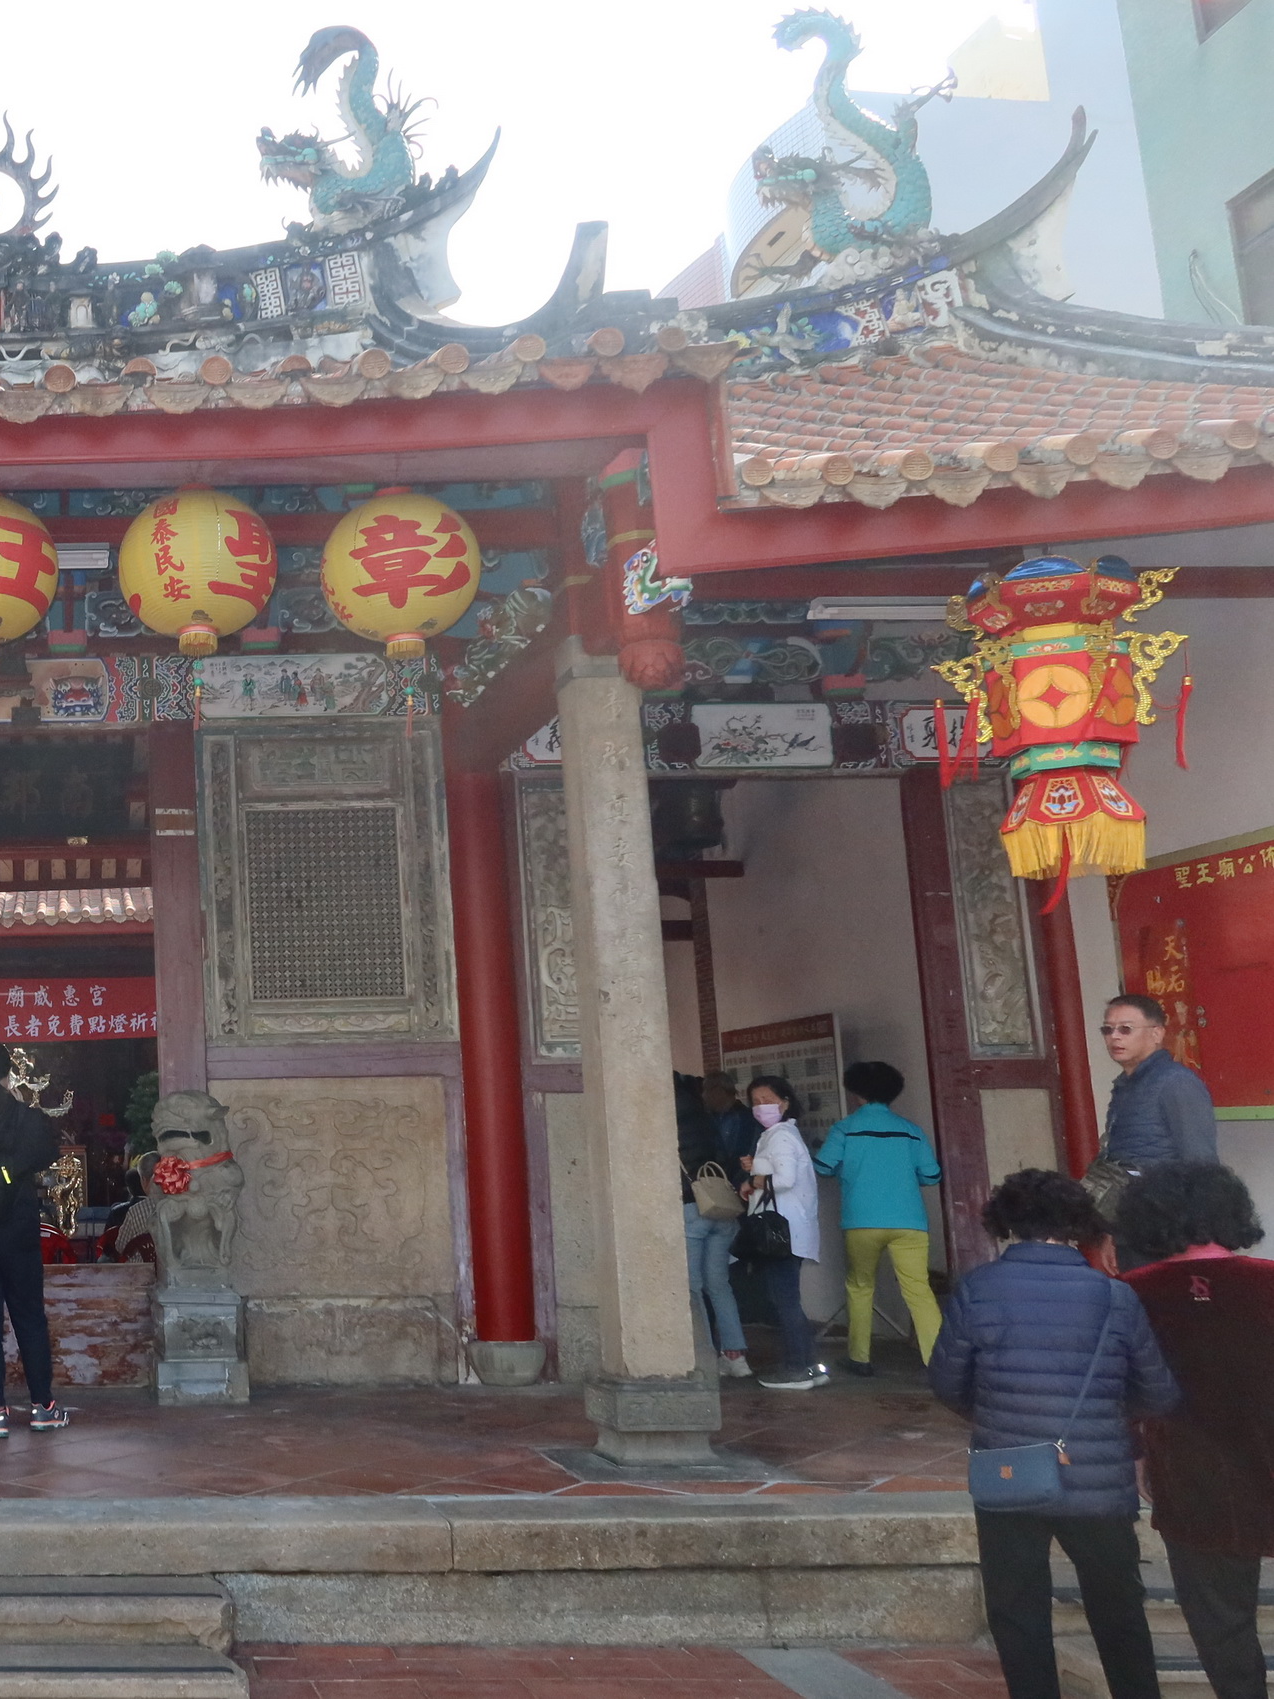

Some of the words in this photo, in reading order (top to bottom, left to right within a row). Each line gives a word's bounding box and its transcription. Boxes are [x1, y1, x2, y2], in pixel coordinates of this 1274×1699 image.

[150, 498, 191, 602] 國泰民安
[349, 514, 472, 608] 彰
